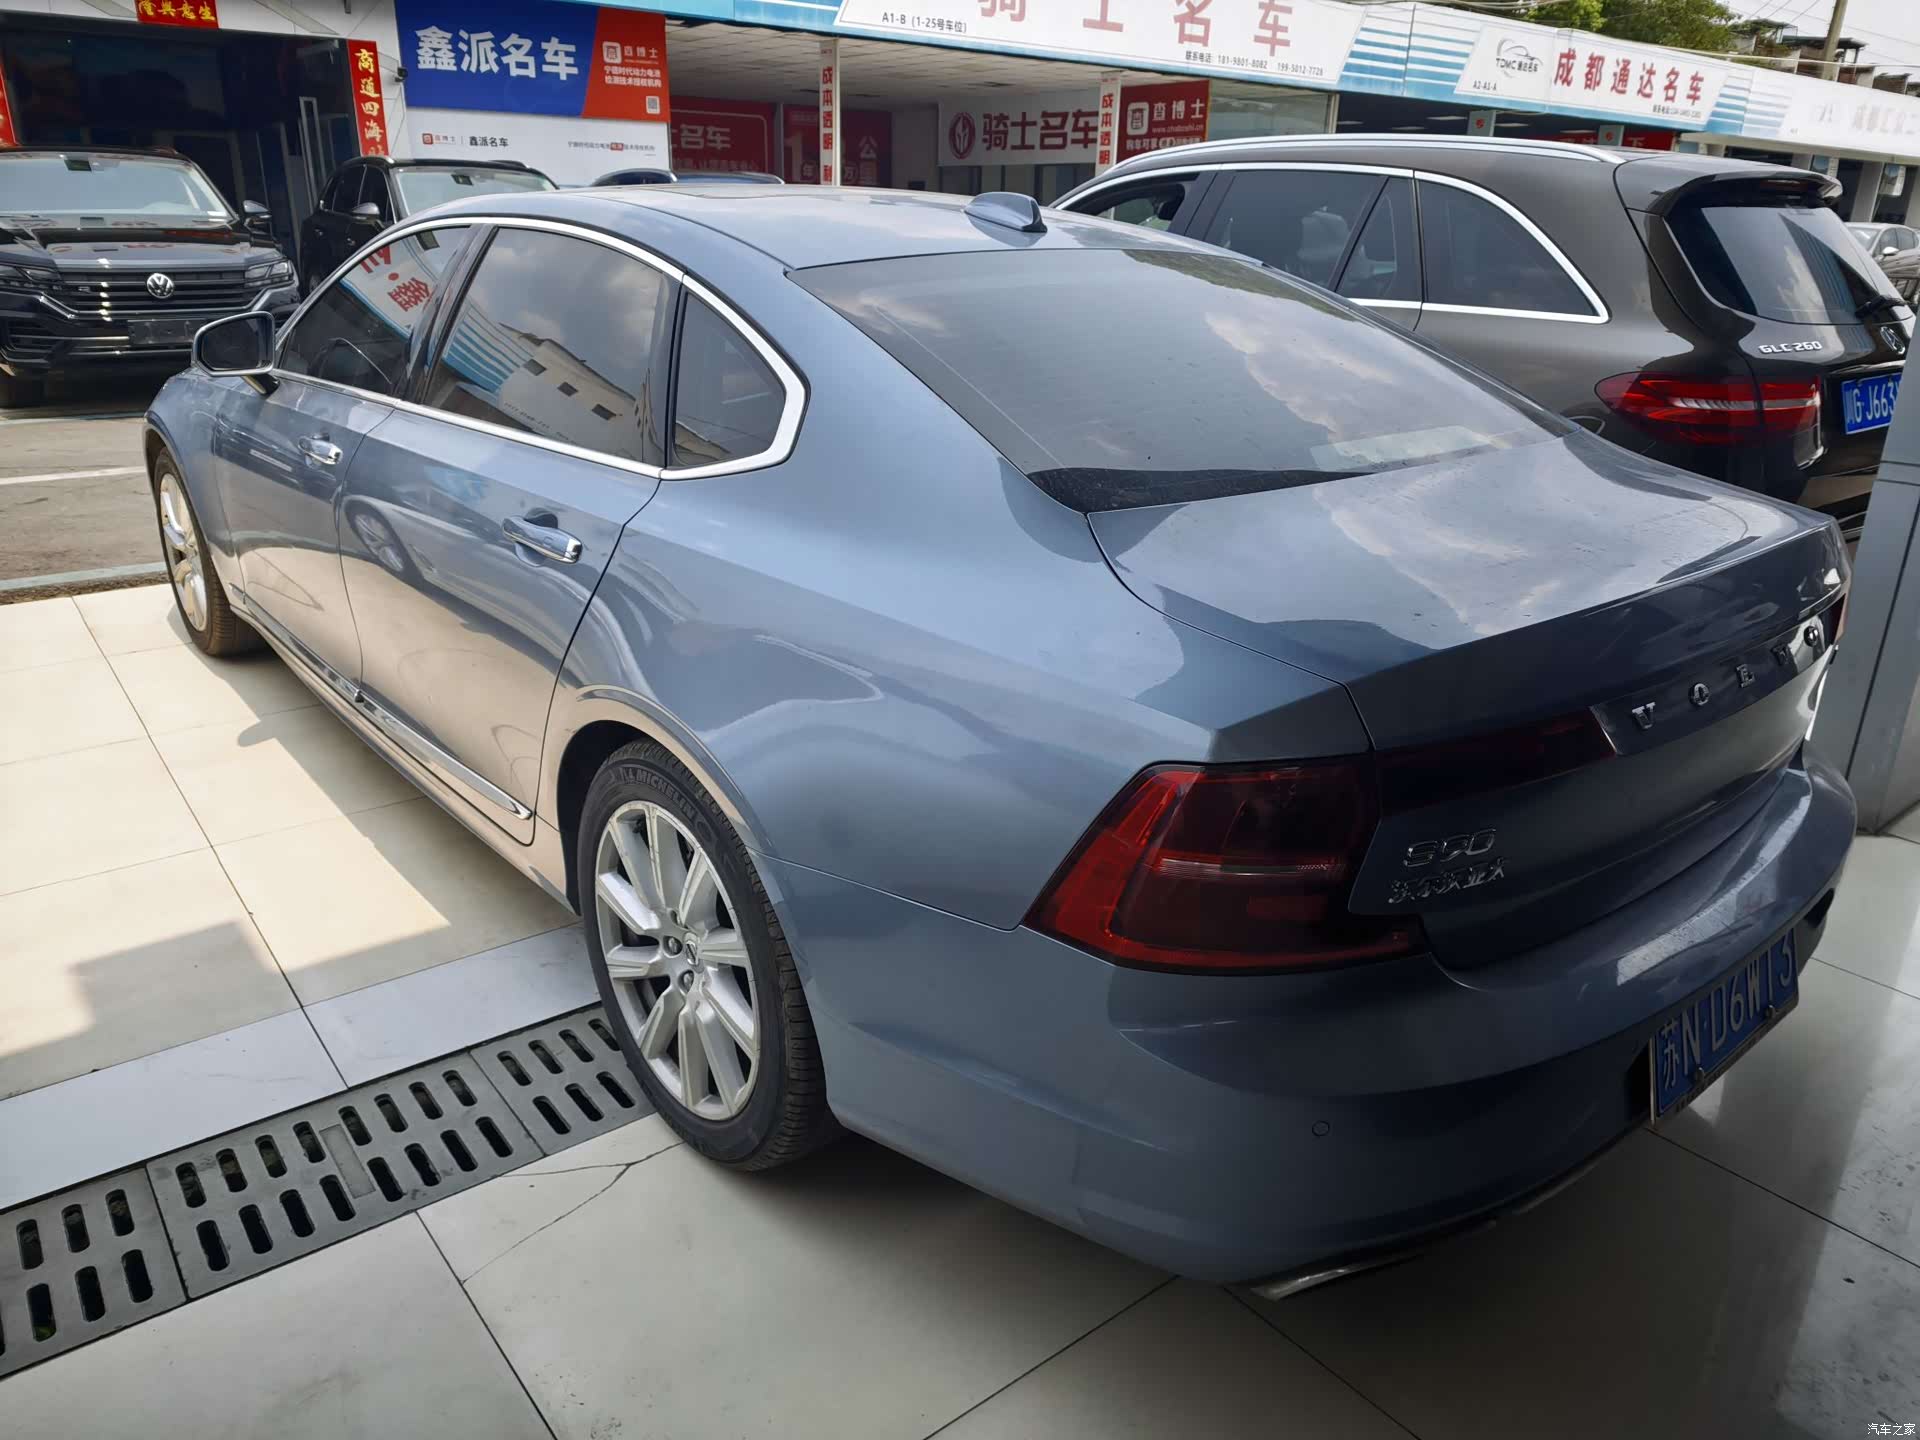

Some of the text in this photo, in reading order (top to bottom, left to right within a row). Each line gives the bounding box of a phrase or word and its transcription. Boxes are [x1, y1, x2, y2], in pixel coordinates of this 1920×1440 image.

[881, 11, 907, 25] A1-B
[415, 25, 579, 81] 鑫派名车
[1554, 48, 1705, 106] 成都通达名车
[355, 48, 385, 156] 商道四海
[982, 109, 1099, 151] 骑士名车
[1098, 92, 1114, 165] 成本透明
[1152, 98, 1205, 121] 查博士
[1758, 340, 1824, 354] GLC 260
[636, 767, 698, 823] MICHELIN
